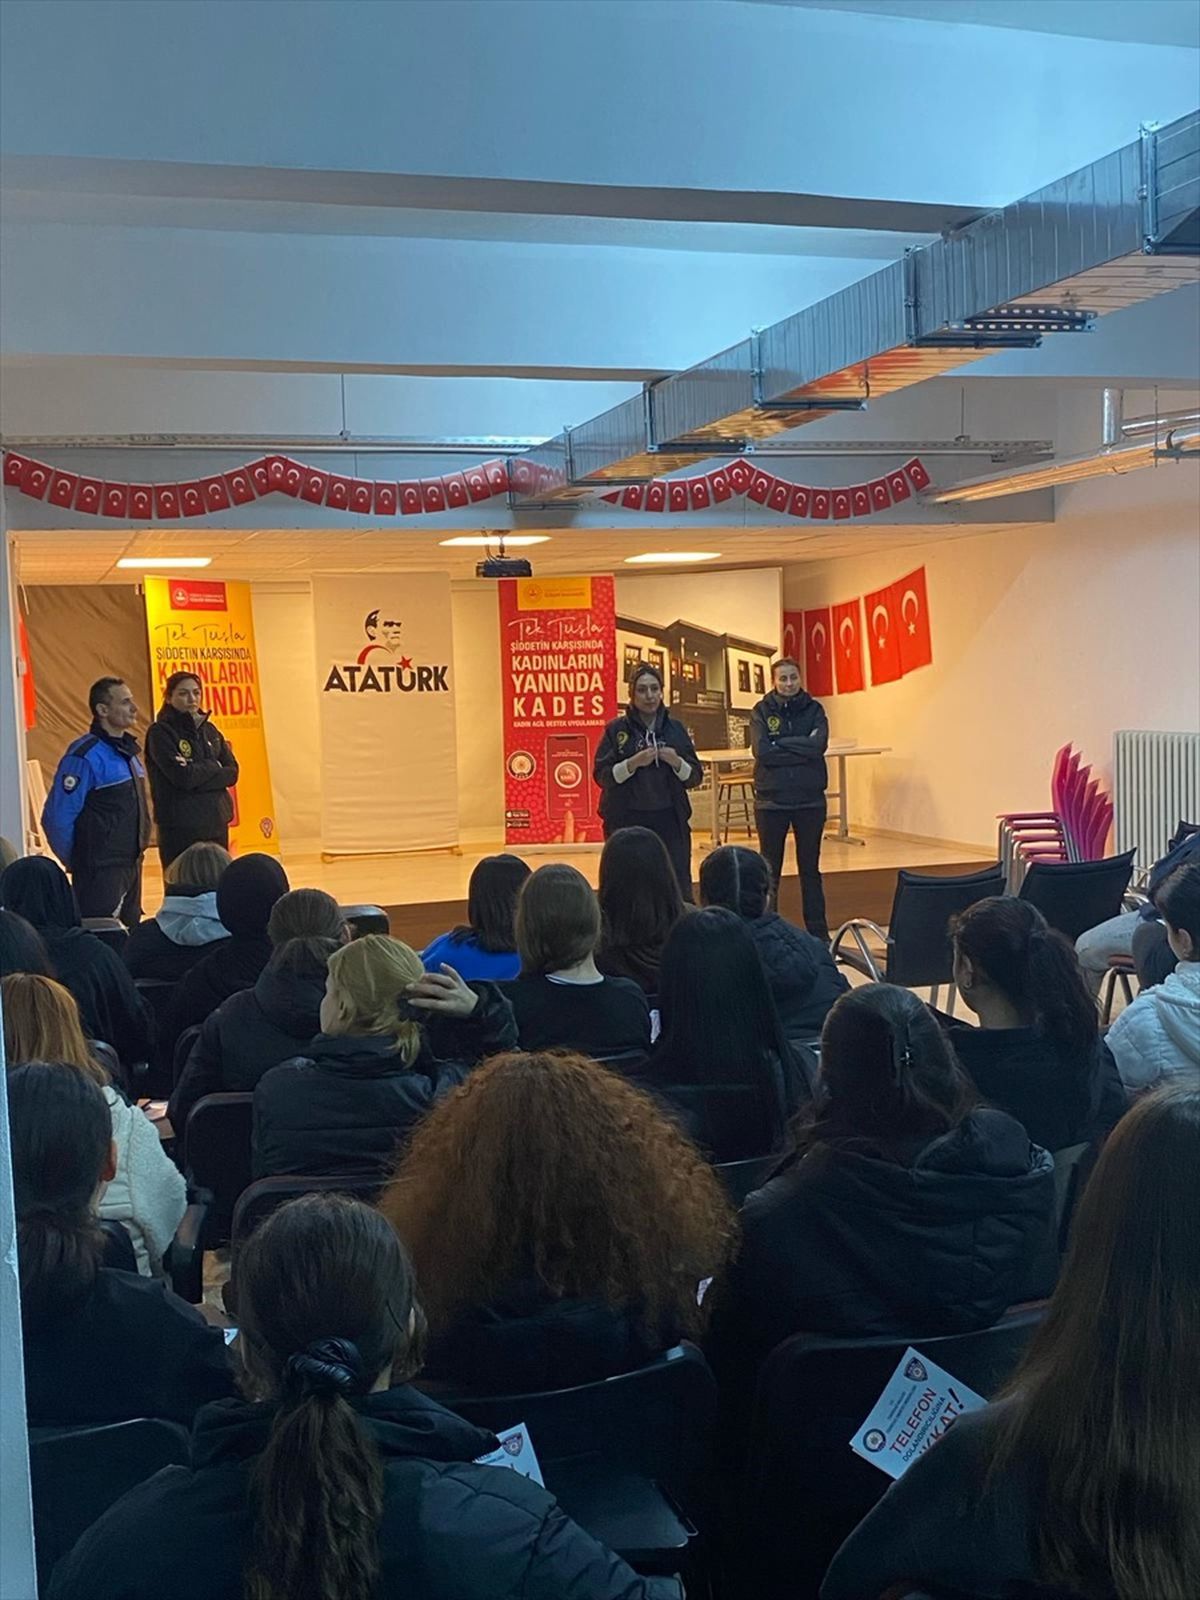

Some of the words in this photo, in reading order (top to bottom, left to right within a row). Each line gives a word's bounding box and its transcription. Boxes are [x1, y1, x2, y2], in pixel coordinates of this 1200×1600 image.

[154, 623, 191, 646] Tek
[508, 618, 546, 641] Tek
[512, 653, 604, 671] KADINLARIN
[511, 671, 605, 694] YANINDA
[513, 695, 604, 717] KADES
[889, 1387, 937, 1454] TELEFON
